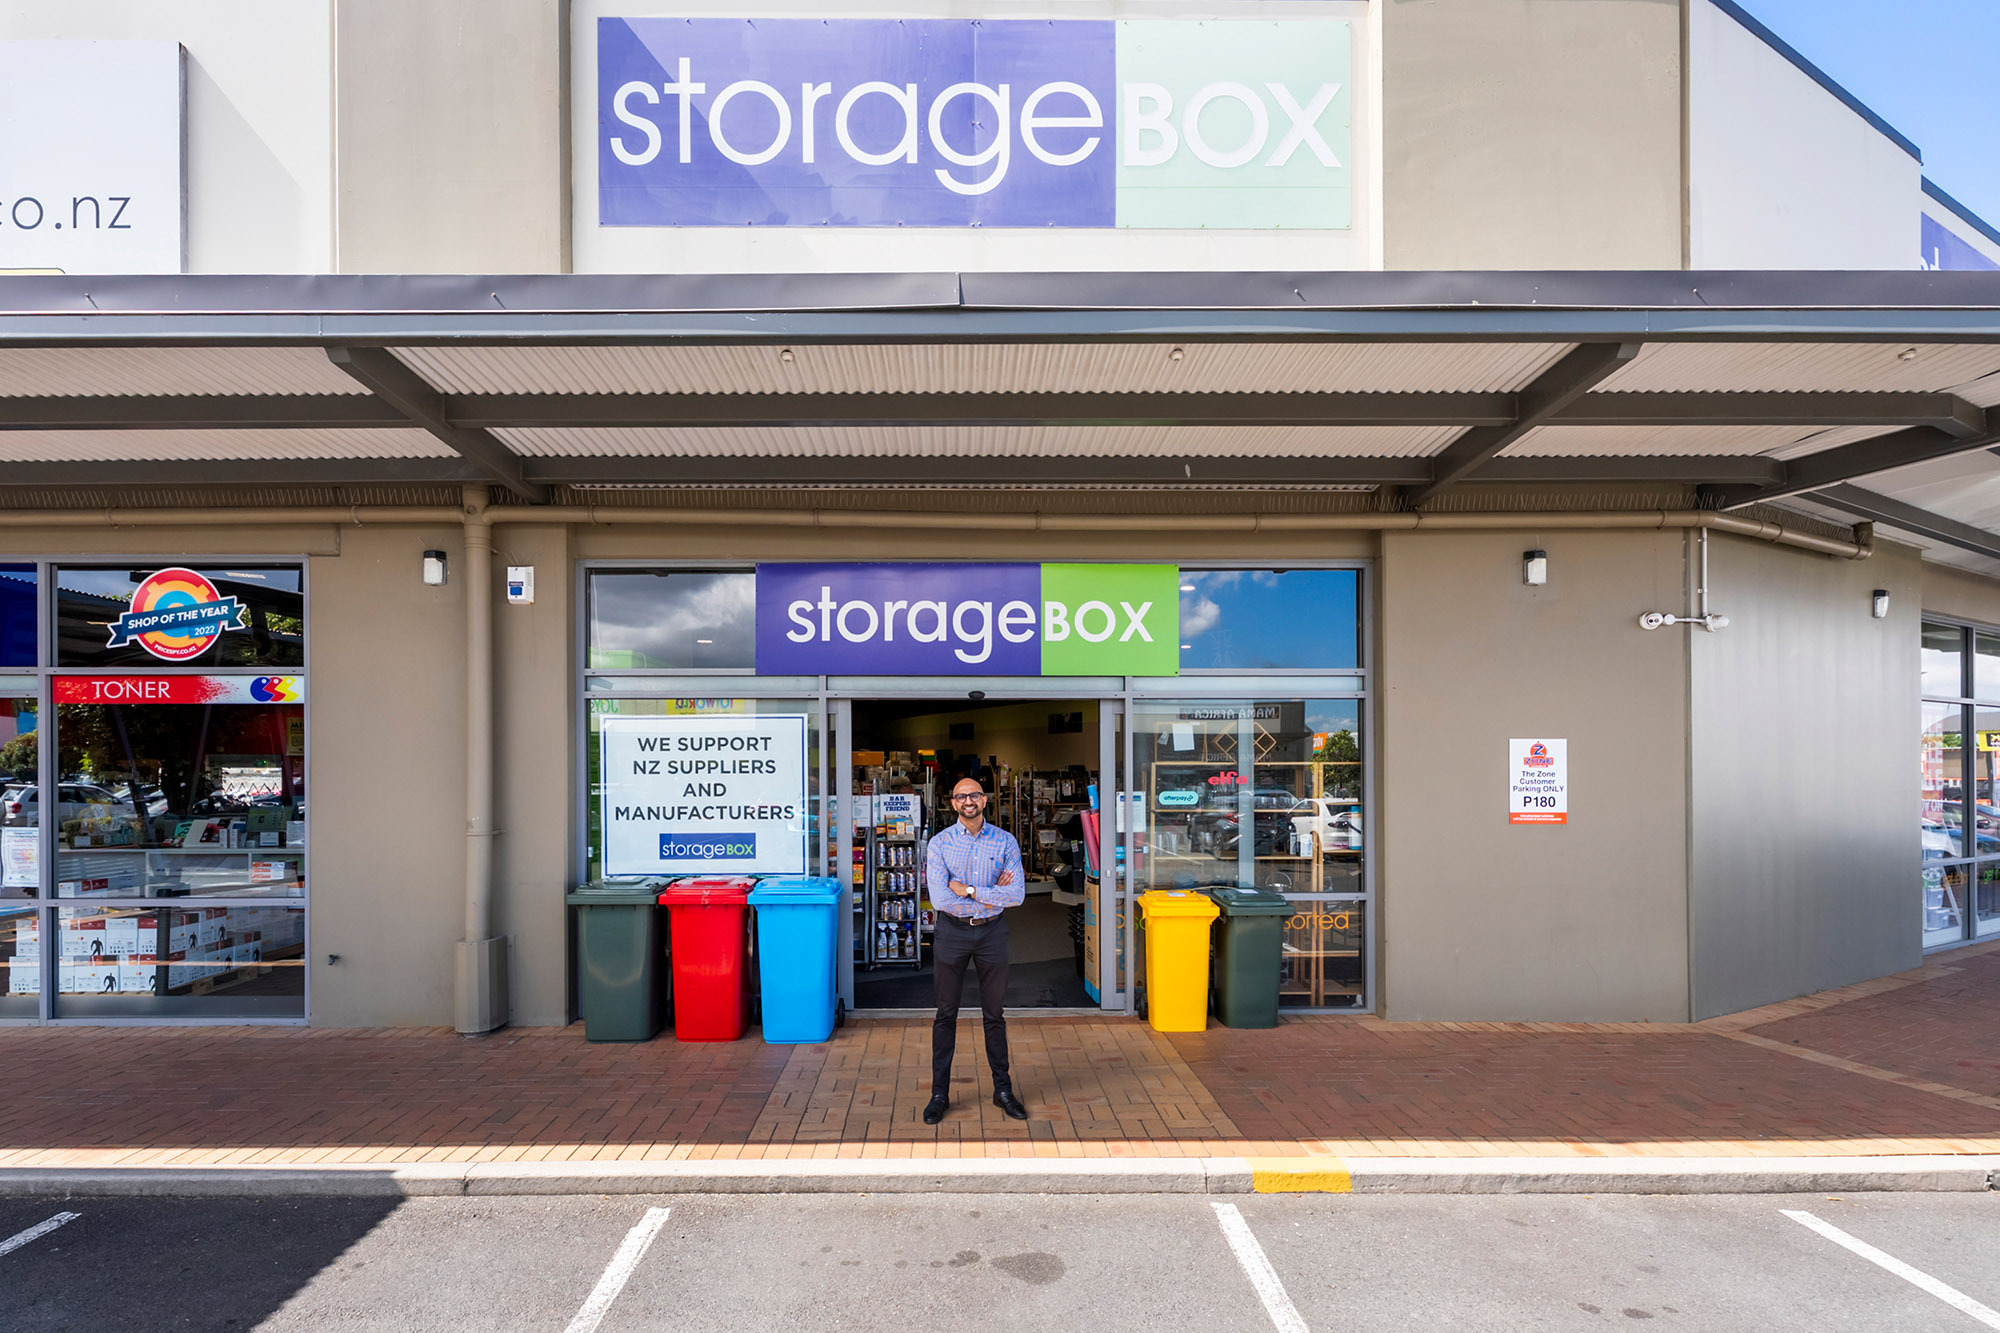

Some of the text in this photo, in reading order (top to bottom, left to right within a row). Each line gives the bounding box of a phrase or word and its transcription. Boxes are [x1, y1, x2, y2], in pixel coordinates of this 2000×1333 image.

[0, 196, 131, 230] o.nz
[128, 605, 229, 629] SHOP OF THE YEAR
[194, 625, 215, 636] 2022
[91, 681, 170, 699] TONER
[638, 736, 772, 752] WE SUPPORT
[633, 760, 776, 774] NZ SUPPLIERS
[1522, 770, 1556, 778] The Zone
[683, 783, 727, 797] AND
[1512, 785, 1541, 793] Parking
[1523, 796, 1556, 807] P180
[615, 805, 795, 820] MANUFACTURERS
